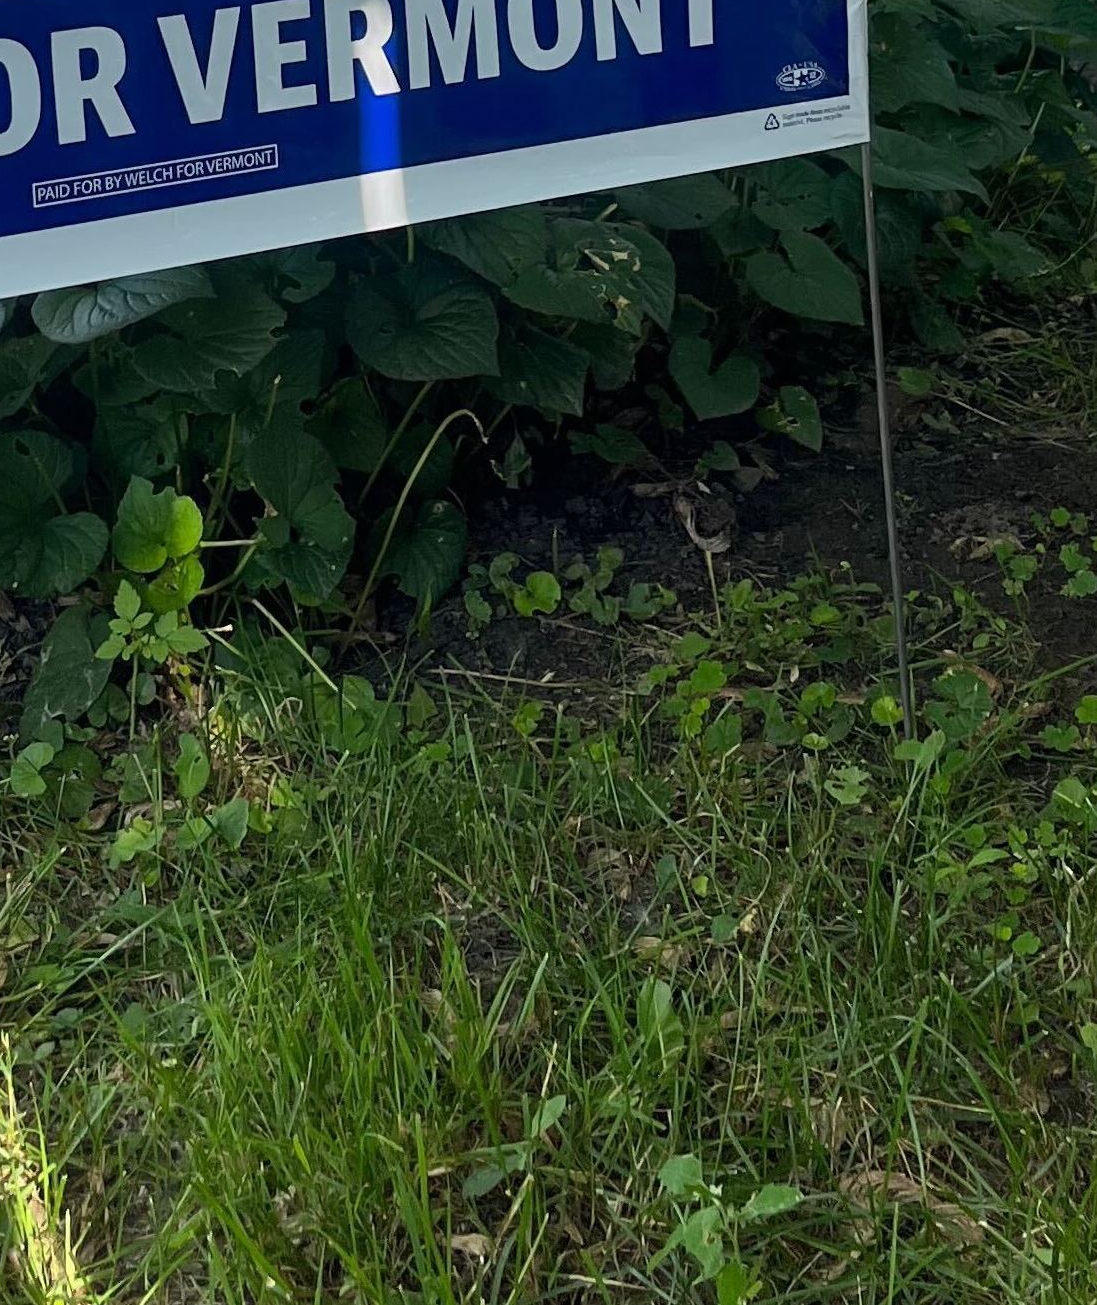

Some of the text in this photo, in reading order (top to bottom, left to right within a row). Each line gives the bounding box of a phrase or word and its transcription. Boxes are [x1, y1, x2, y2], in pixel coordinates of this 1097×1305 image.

[37, 149, 274, 203] PAID FOR BY WELCH FOR VERMONT
